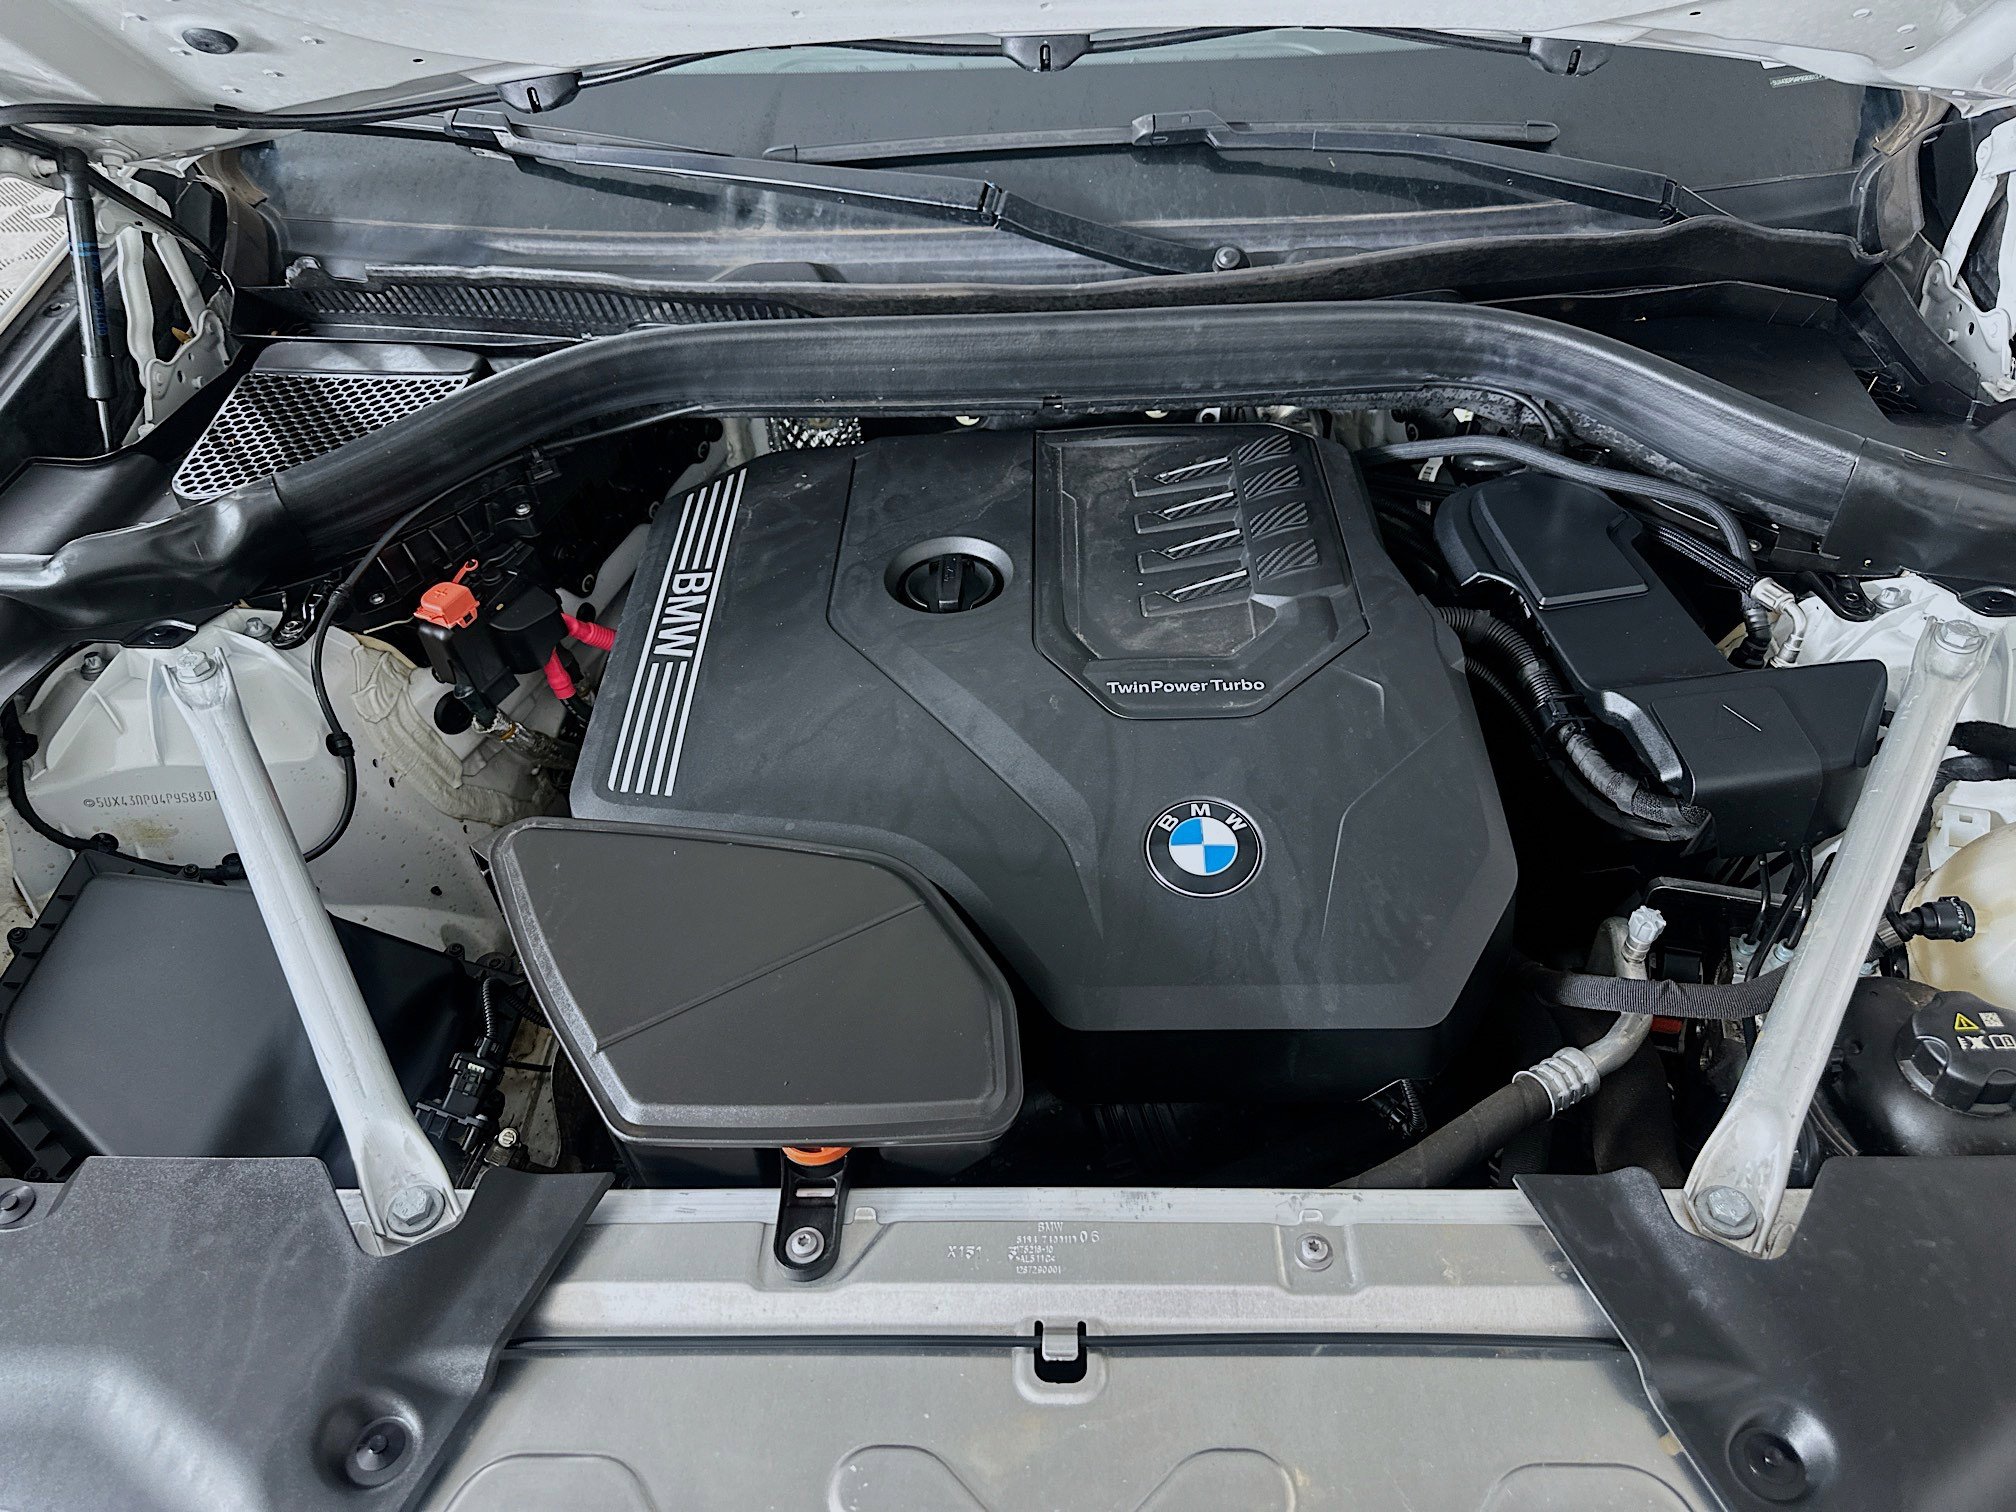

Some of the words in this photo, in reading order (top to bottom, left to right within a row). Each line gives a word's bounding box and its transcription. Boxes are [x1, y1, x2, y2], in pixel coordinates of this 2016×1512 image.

[653, 572, 713, 657] BMW
[1106, 680, 1208, 694] TwinPower
[1210, 678, 1265, 692] Turbo
[1157, 803, 1248, 832] BMW
[1038, 1221, 1064, 1232] BMW
